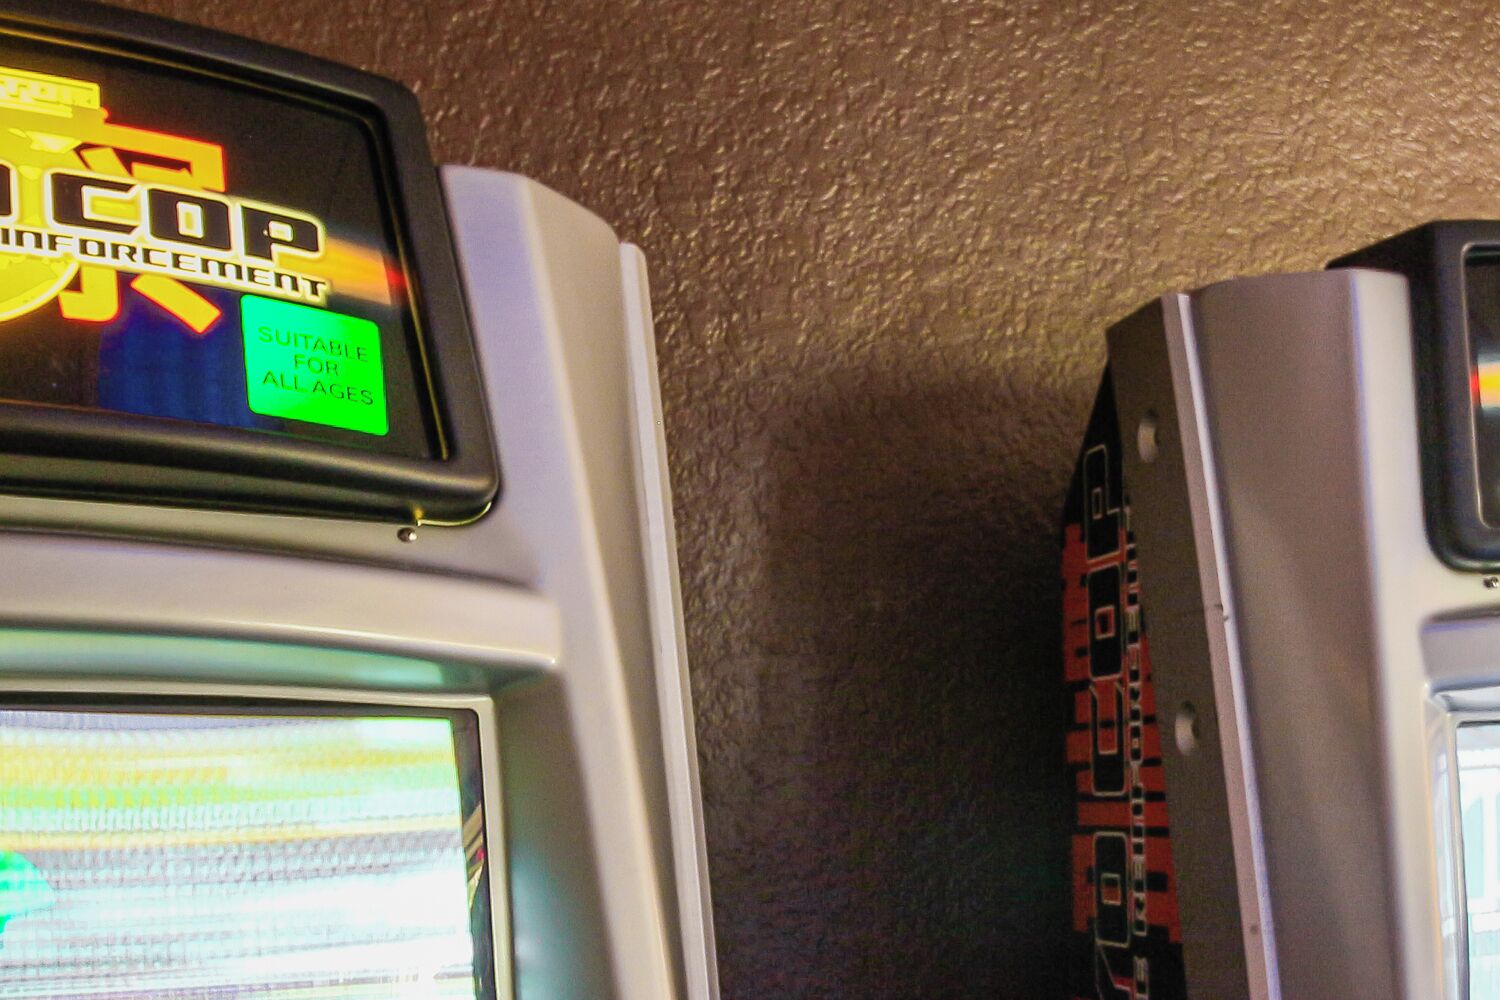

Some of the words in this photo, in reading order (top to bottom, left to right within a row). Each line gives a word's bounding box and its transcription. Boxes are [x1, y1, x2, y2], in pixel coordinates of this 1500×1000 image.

[51, 171, 320, 262] COP
[257, 325, 369, 363] SUITABLE
[293, 353, 339, 376] FOR
[262, 369, 308, 392] ALL
[312, 380, 374, 406] AGES
